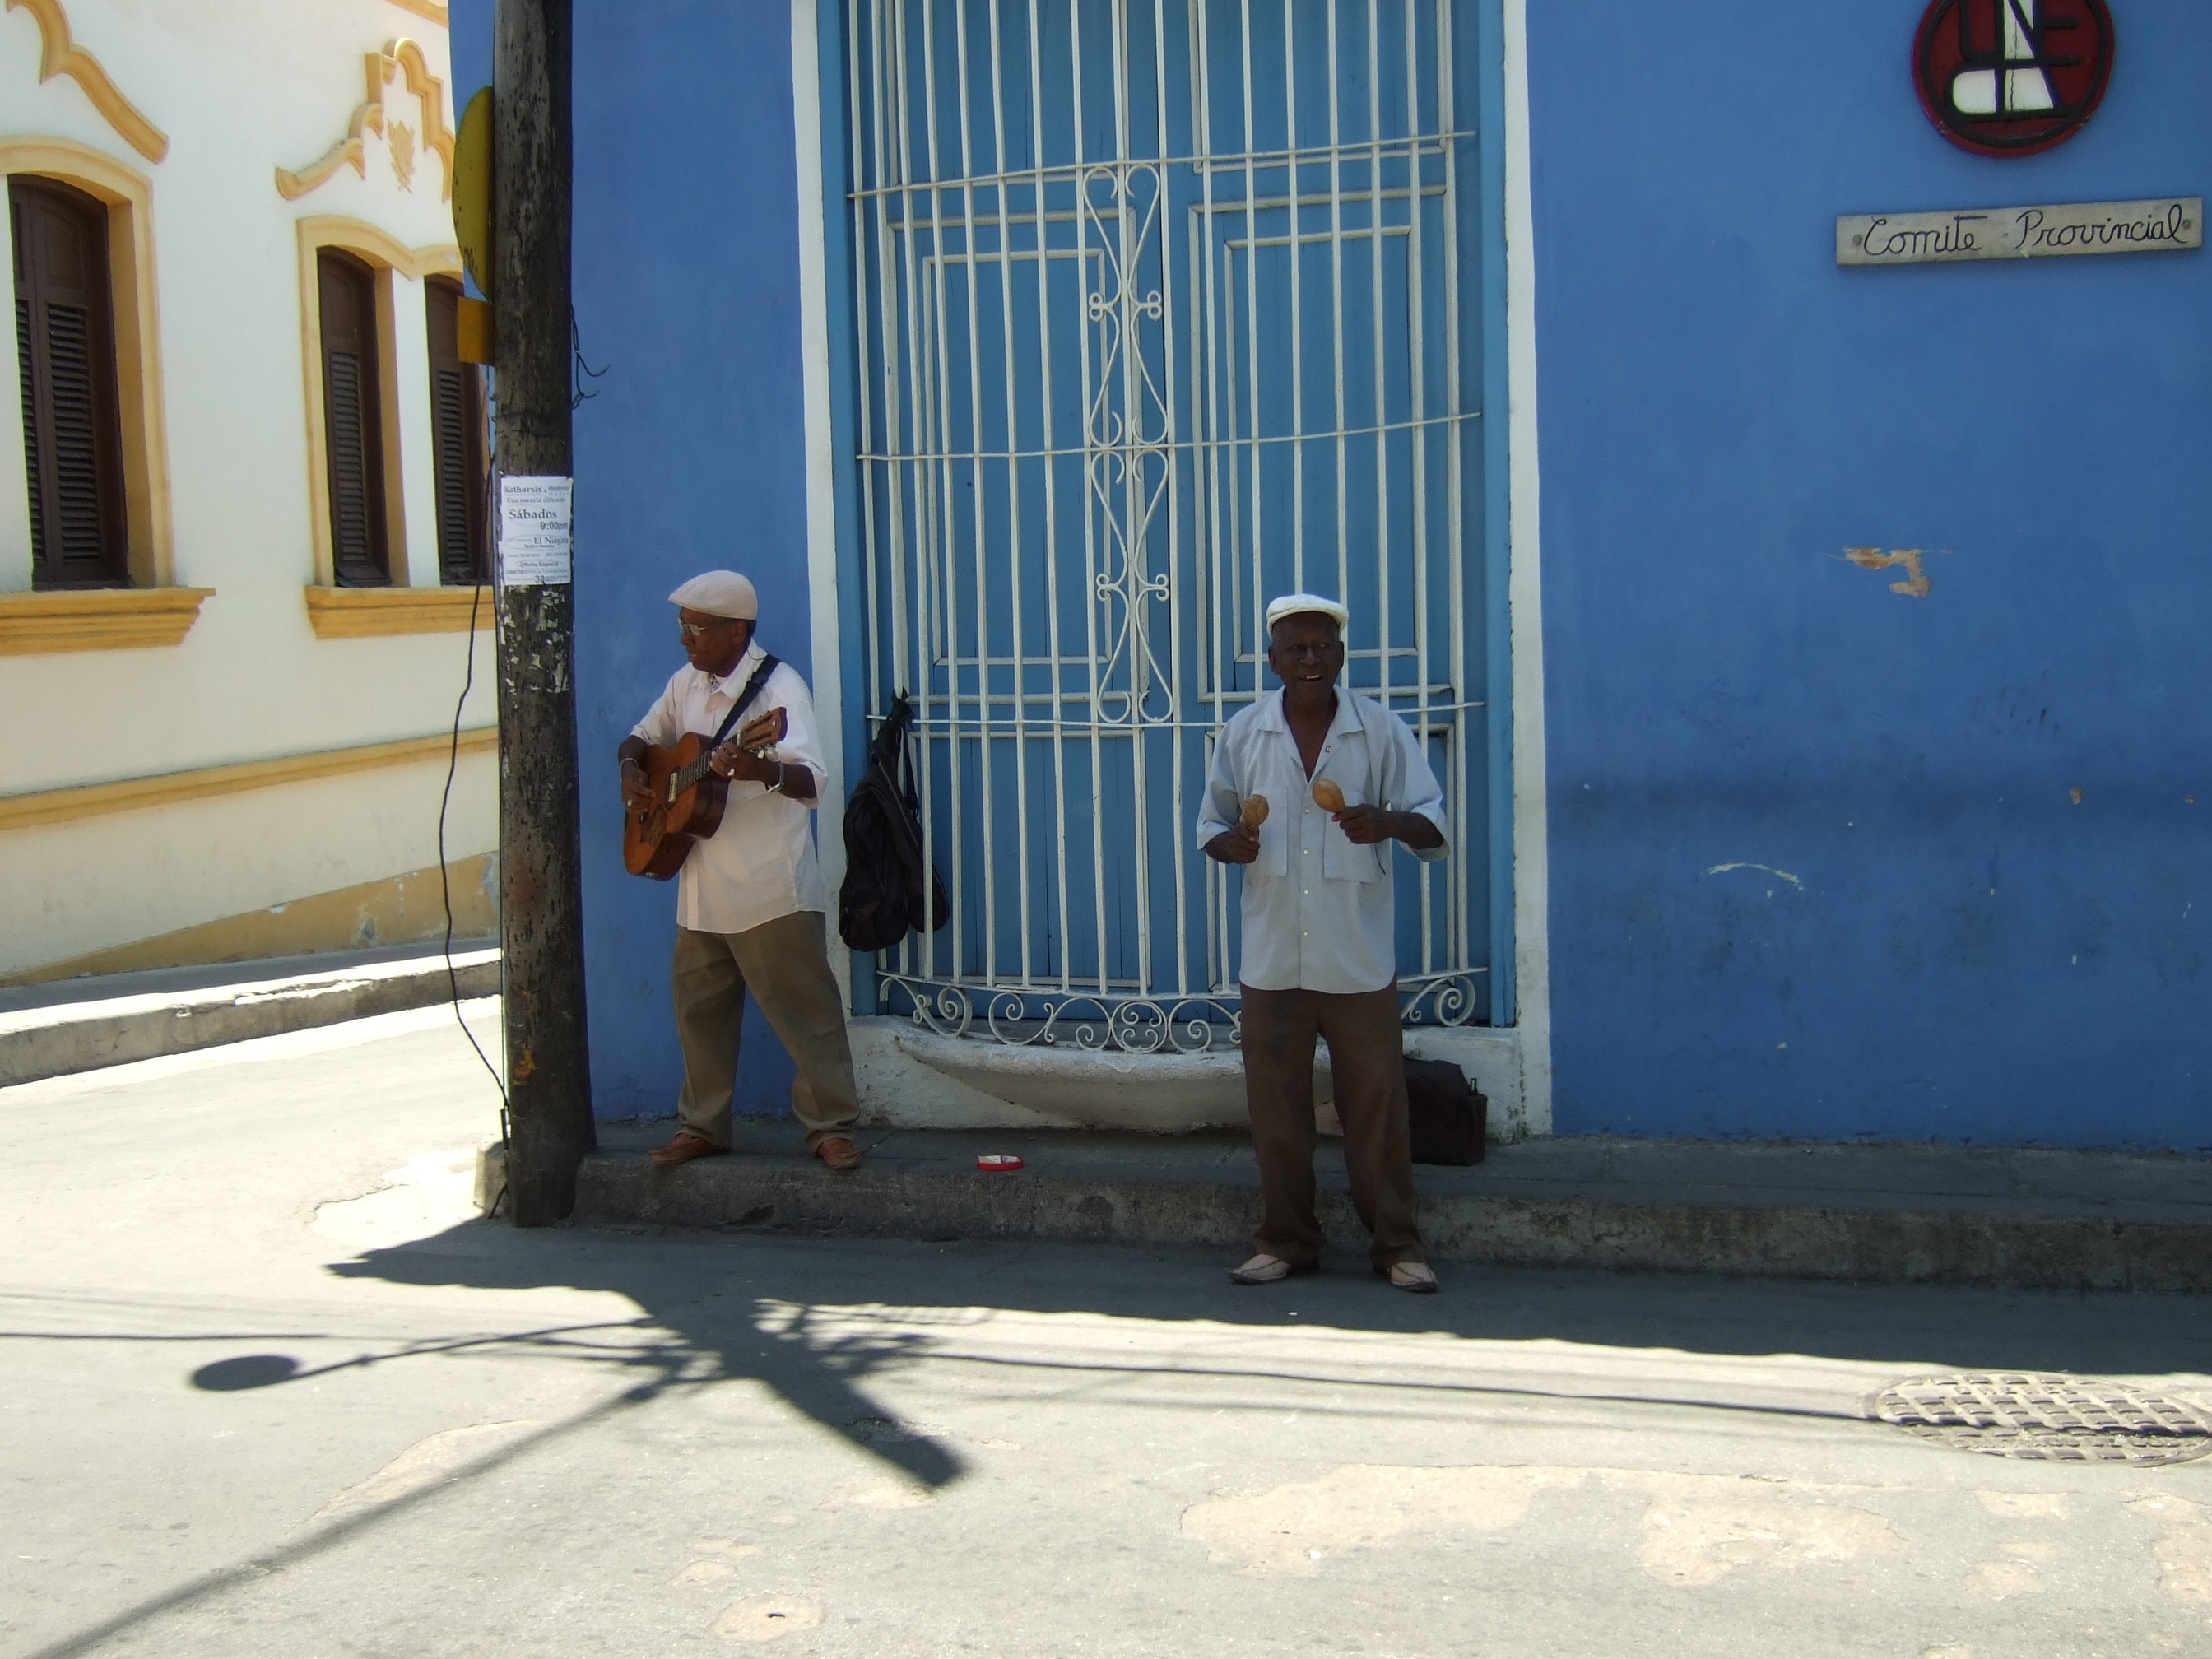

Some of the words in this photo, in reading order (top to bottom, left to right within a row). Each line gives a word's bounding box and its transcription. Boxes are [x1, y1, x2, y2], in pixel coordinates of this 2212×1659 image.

[2014, 203, 2190, 249] Provincial
[509, 508, 557, 520] Sábados
[540, 521, 569, 531] 9:00pm
